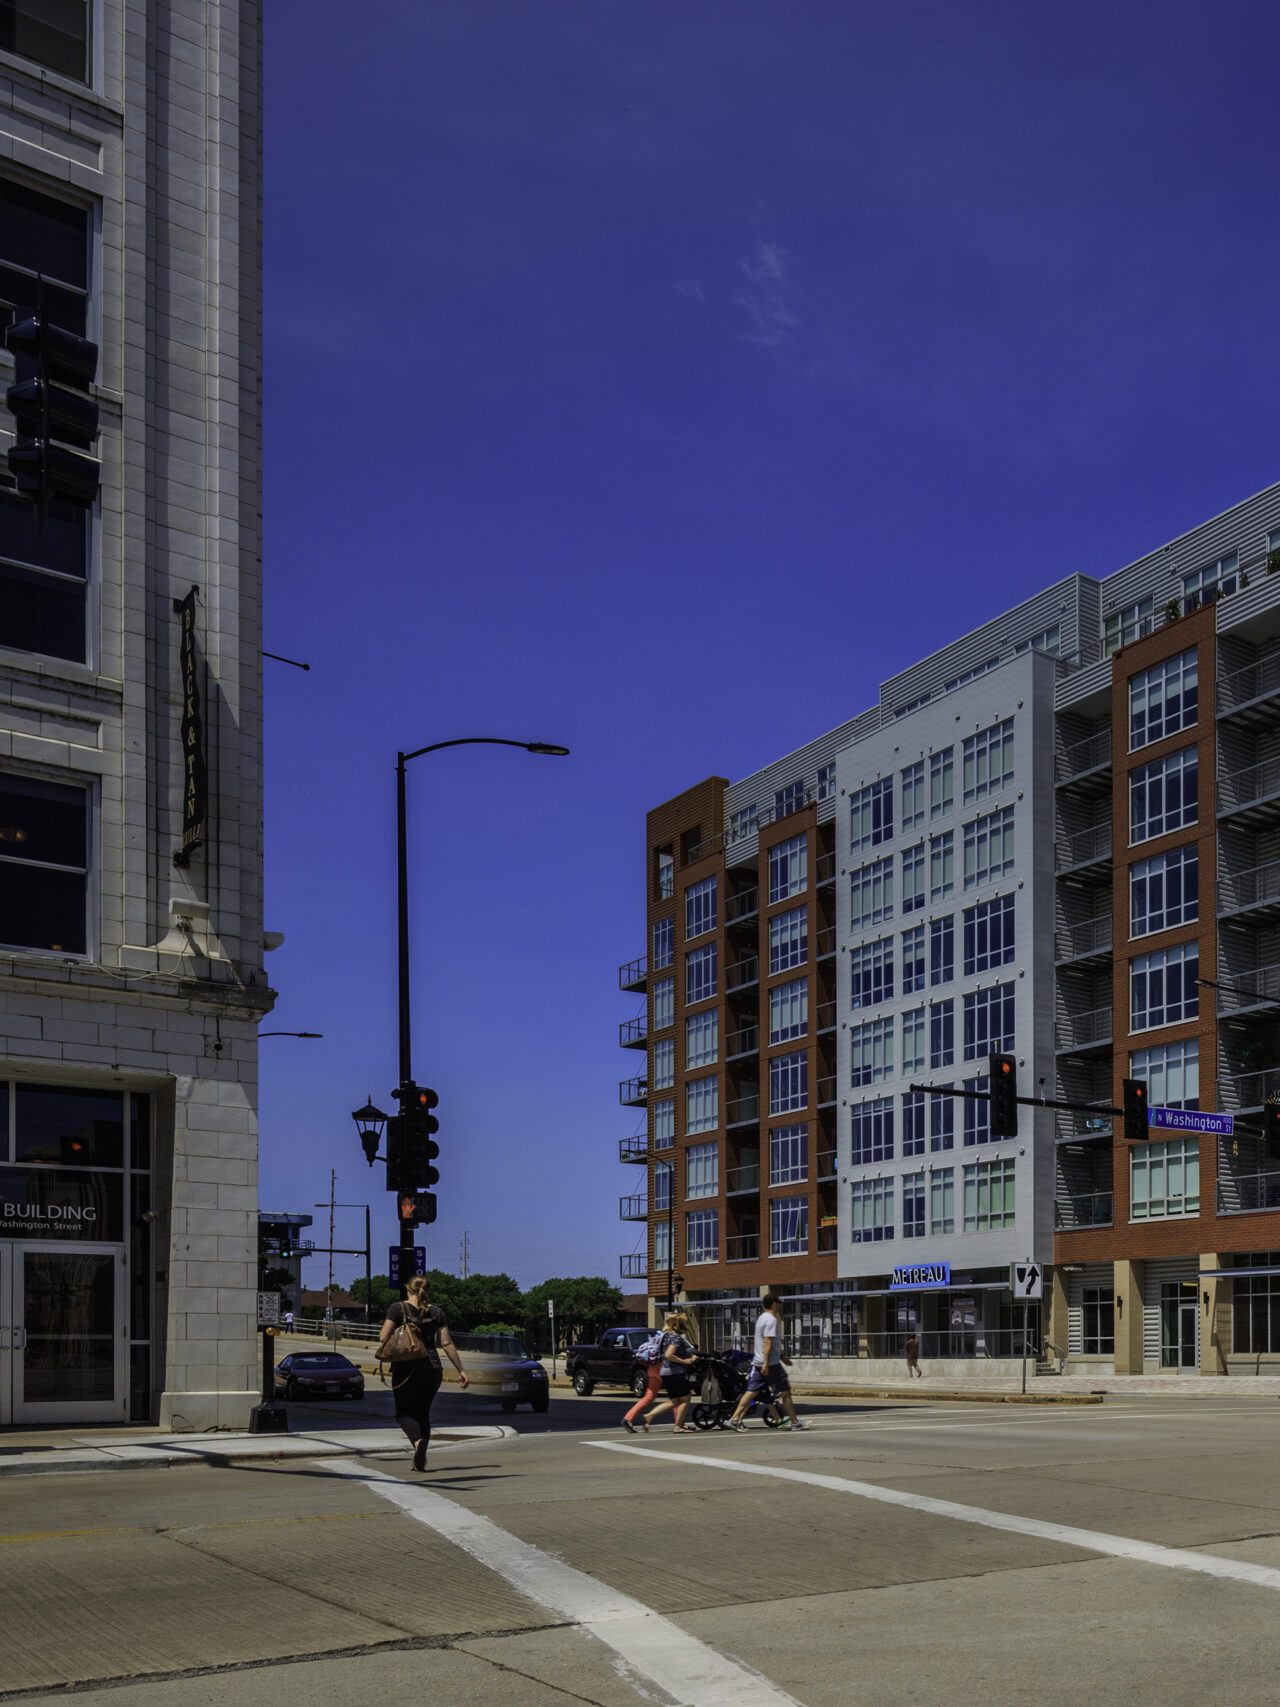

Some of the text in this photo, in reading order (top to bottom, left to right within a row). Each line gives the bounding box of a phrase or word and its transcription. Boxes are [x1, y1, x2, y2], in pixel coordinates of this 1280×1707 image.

[185, 608, 196, 819] BLACK & TAN
[1157, 1111, 1222, 1131] N Washington
[4, 1202, 97, 1221] BUILDING
[54, 1222, 82, 1231] Street
[391, 1254, 399, 1281] BUS
[416, 1250, 424, 1276] STO
[892, 1266, 944, 1285] METREAU
